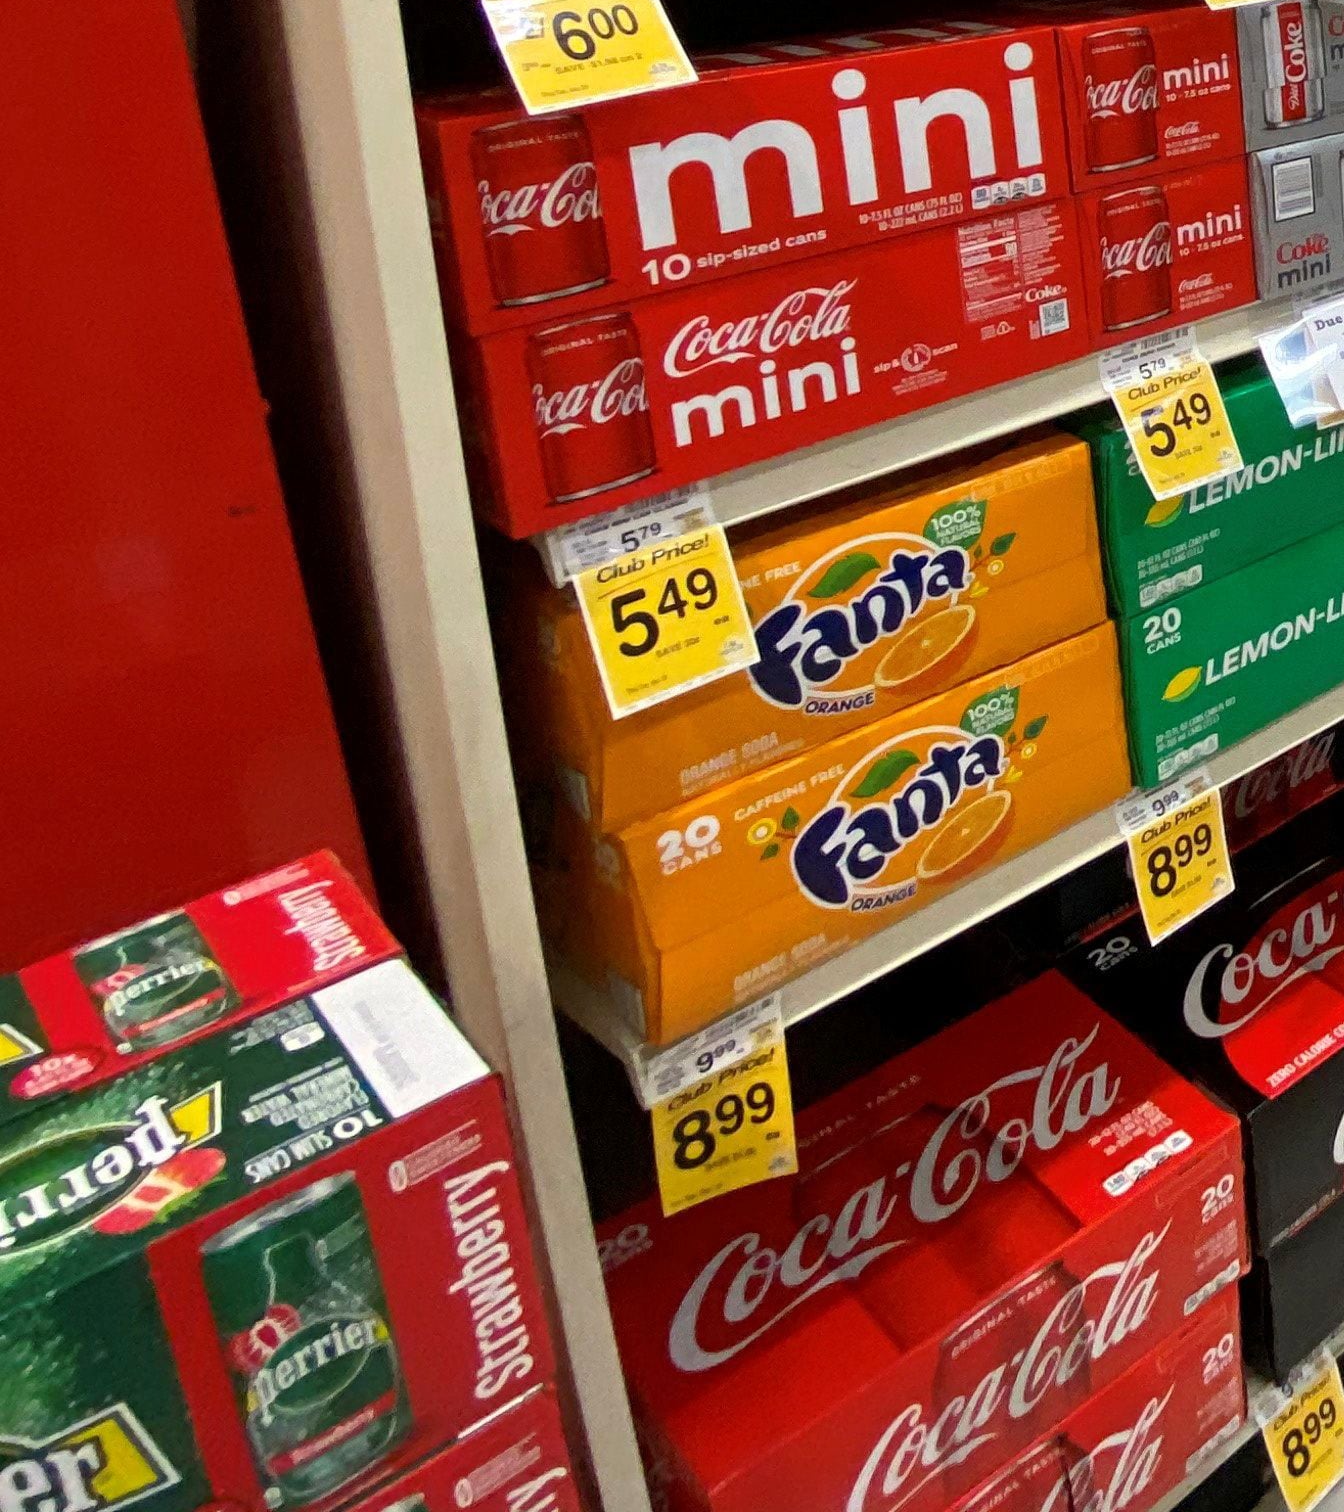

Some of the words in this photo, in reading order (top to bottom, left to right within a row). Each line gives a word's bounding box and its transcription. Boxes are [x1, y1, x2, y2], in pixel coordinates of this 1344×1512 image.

[1163, 53, 1231, 91] mini
[630, 42, 1043, 250] mini
[1177, 204, 1242, 246] mini
[642, 254, 691, 286] 10
[697, 239, 781, 268] sip-sized
[785, 228, 828, 250] cans
[1278, 255, 1332, 288] mini
[1315, 315, 1343, 331] Due
[671, 338, 861, 448] mini
[1127, 375, 1162, 401] Club
[1164, 365, 1201, 388] Price!
[929, 504, 983, 533] 100%
[595, 552, 645, 585] Club
[651, 534, 710, 568] Price!
[753, 547, 969, 706] Fanta
[1142, 606, 1182, 642] 20
[1146, 631, 1182, 655] CANS
[804, 691, 876, 715] ORANGE
[967, 688, 1015, 720] 100%
[734, 780, 808, 822] CAFFEINE
[810, 763, 847, 786] FREE
[656, 815, 721, 862] 20
[796, 736, 1003, 905] Fanta
[660, 841, 723, 876] CANS
[851, 884, 918, 913] ORANGE
[278, 879, 366, 972] Strawberry
[1087, 934, 1131, 964] 20
[109, 956, 208, 1003] perrier
[667, 1080, 711, 1112] Club
[715, 1047, 774, 1088] Price!
[1265, 1059, 1296, 1088] ZERO
[1295, 1033, 1335, 1070] CALORIE
[290, 1130, 334, 1160] SLIM
[333, 1109, 384, 1139] 10
[444, 1159, 536, 1400] Strawberry
[250, 1317, 382, 1409] perrier
